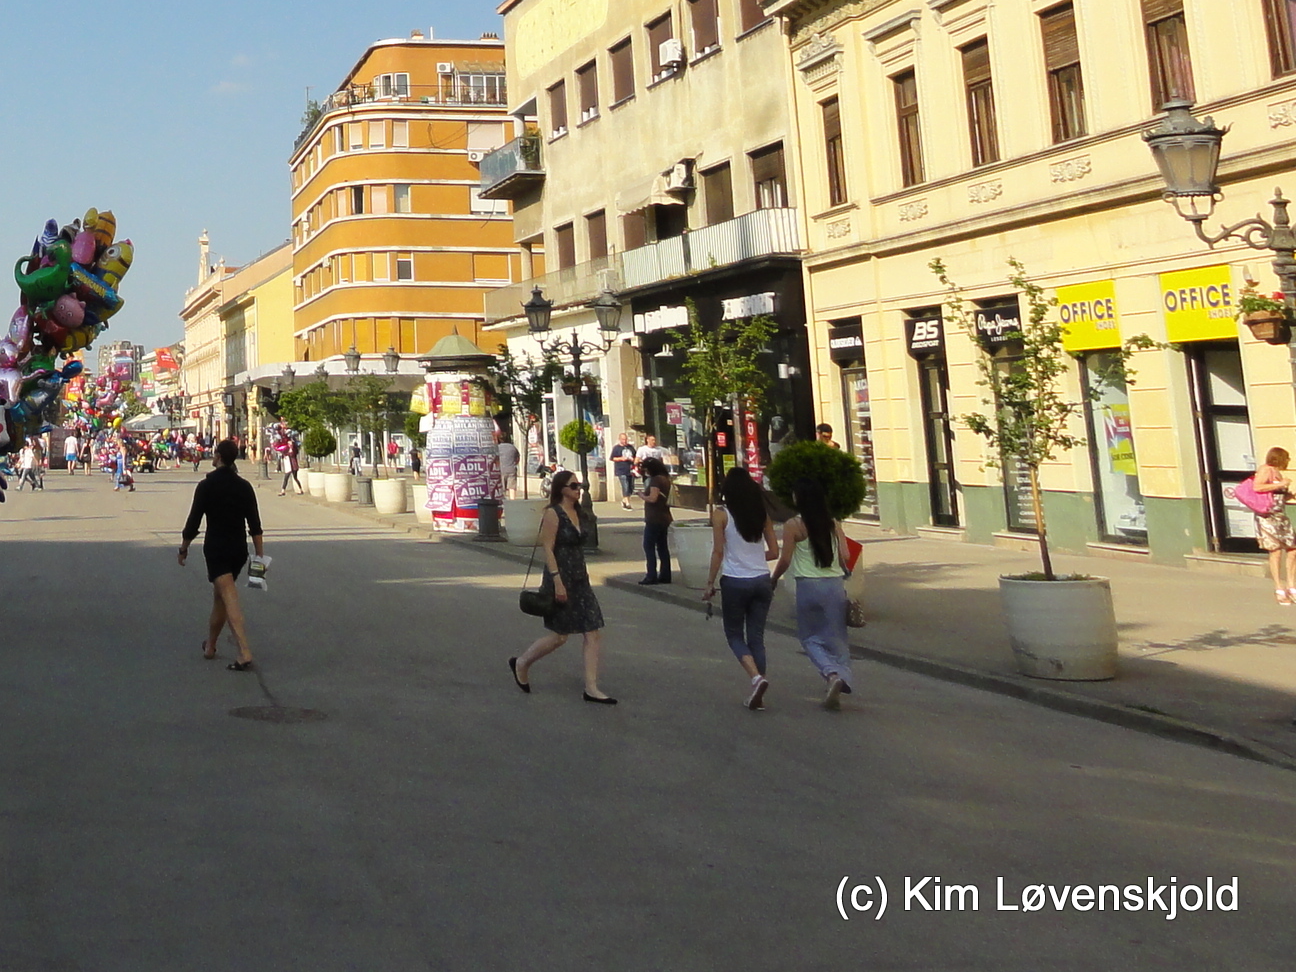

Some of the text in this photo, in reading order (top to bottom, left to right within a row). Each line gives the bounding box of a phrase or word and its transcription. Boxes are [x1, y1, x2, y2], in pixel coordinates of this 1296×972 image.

[1164, 284, 1231, 312] OFFICE
[1060, 298, 1114, 324] OFFICE
[1208, 308, 1234, 319] SHOES
[912, 320, 939, 341] BS
[459, 462, 484, 471] ADIL
[461, 486, 485, 497] ADIL
